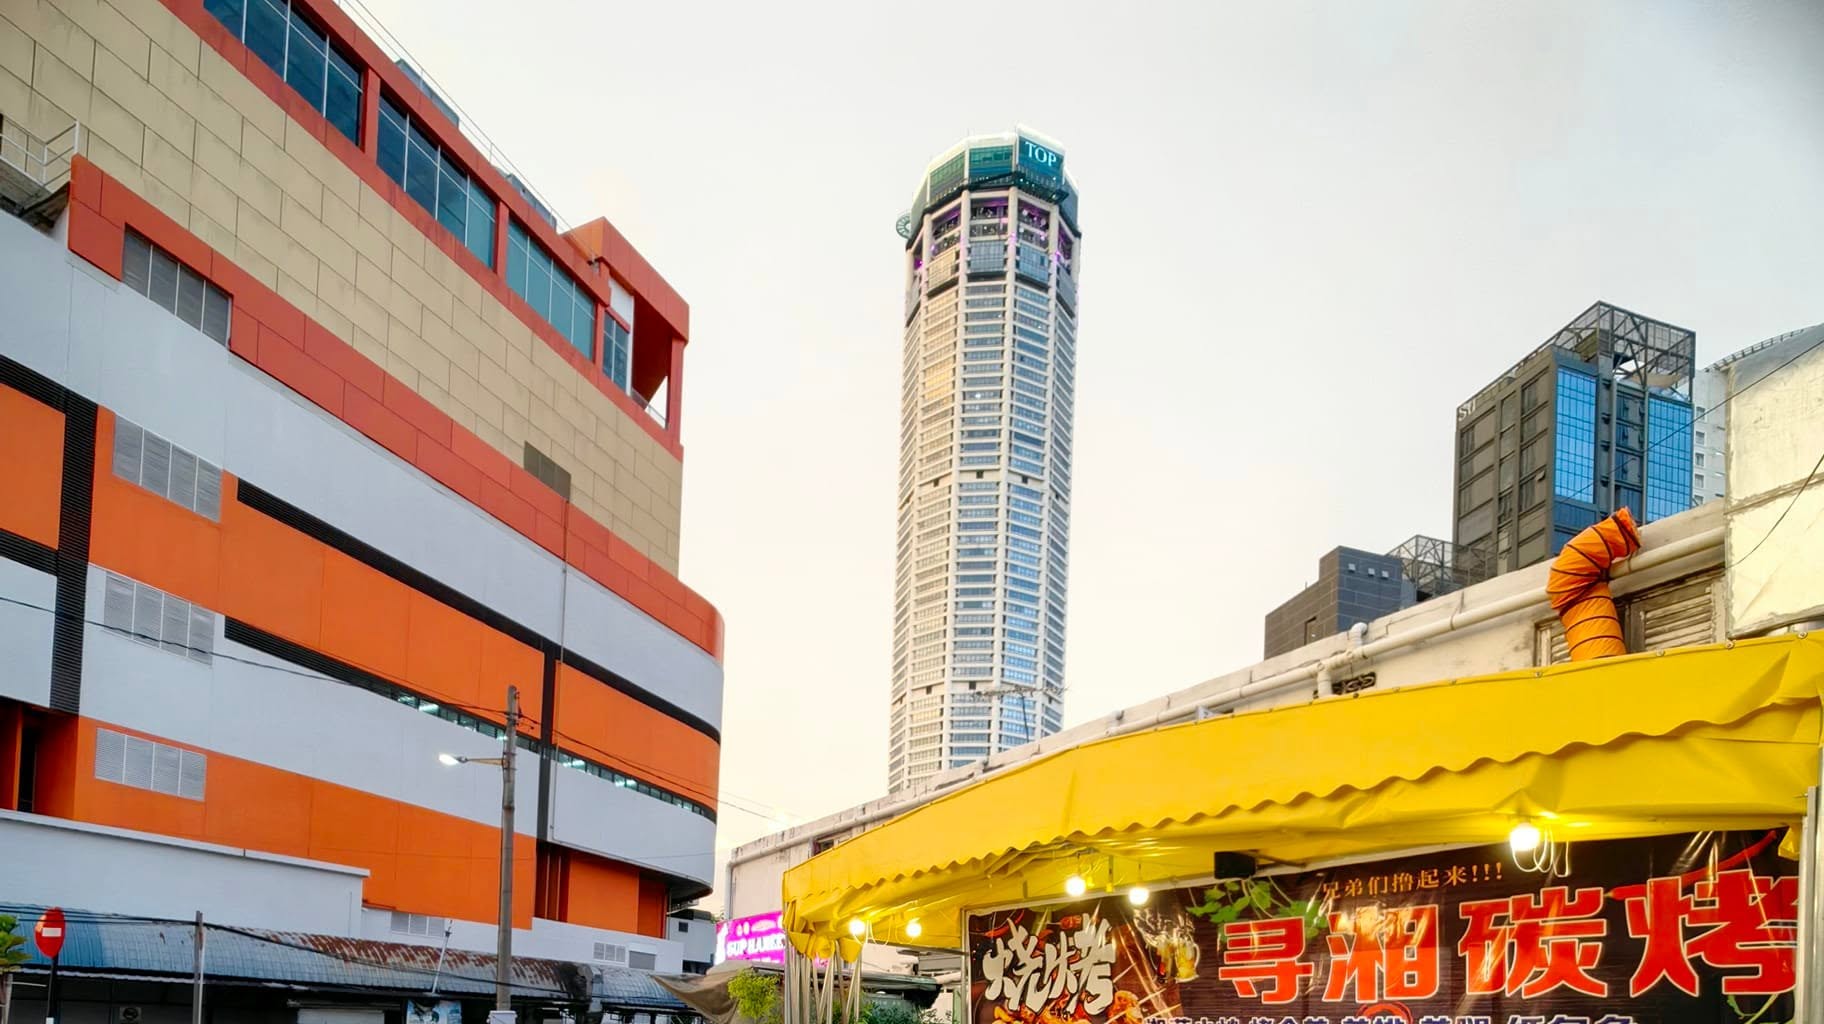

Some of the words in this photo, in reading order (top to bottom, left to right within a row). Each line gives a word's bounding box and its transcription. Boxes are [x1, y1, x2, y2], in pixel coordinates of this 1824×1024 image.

[1025, 141, 1057, 167] TOP
[981, 912, 1117, 1016] 烧烤
[1218, 867, 1799, 1005] 寻湘碳烤
